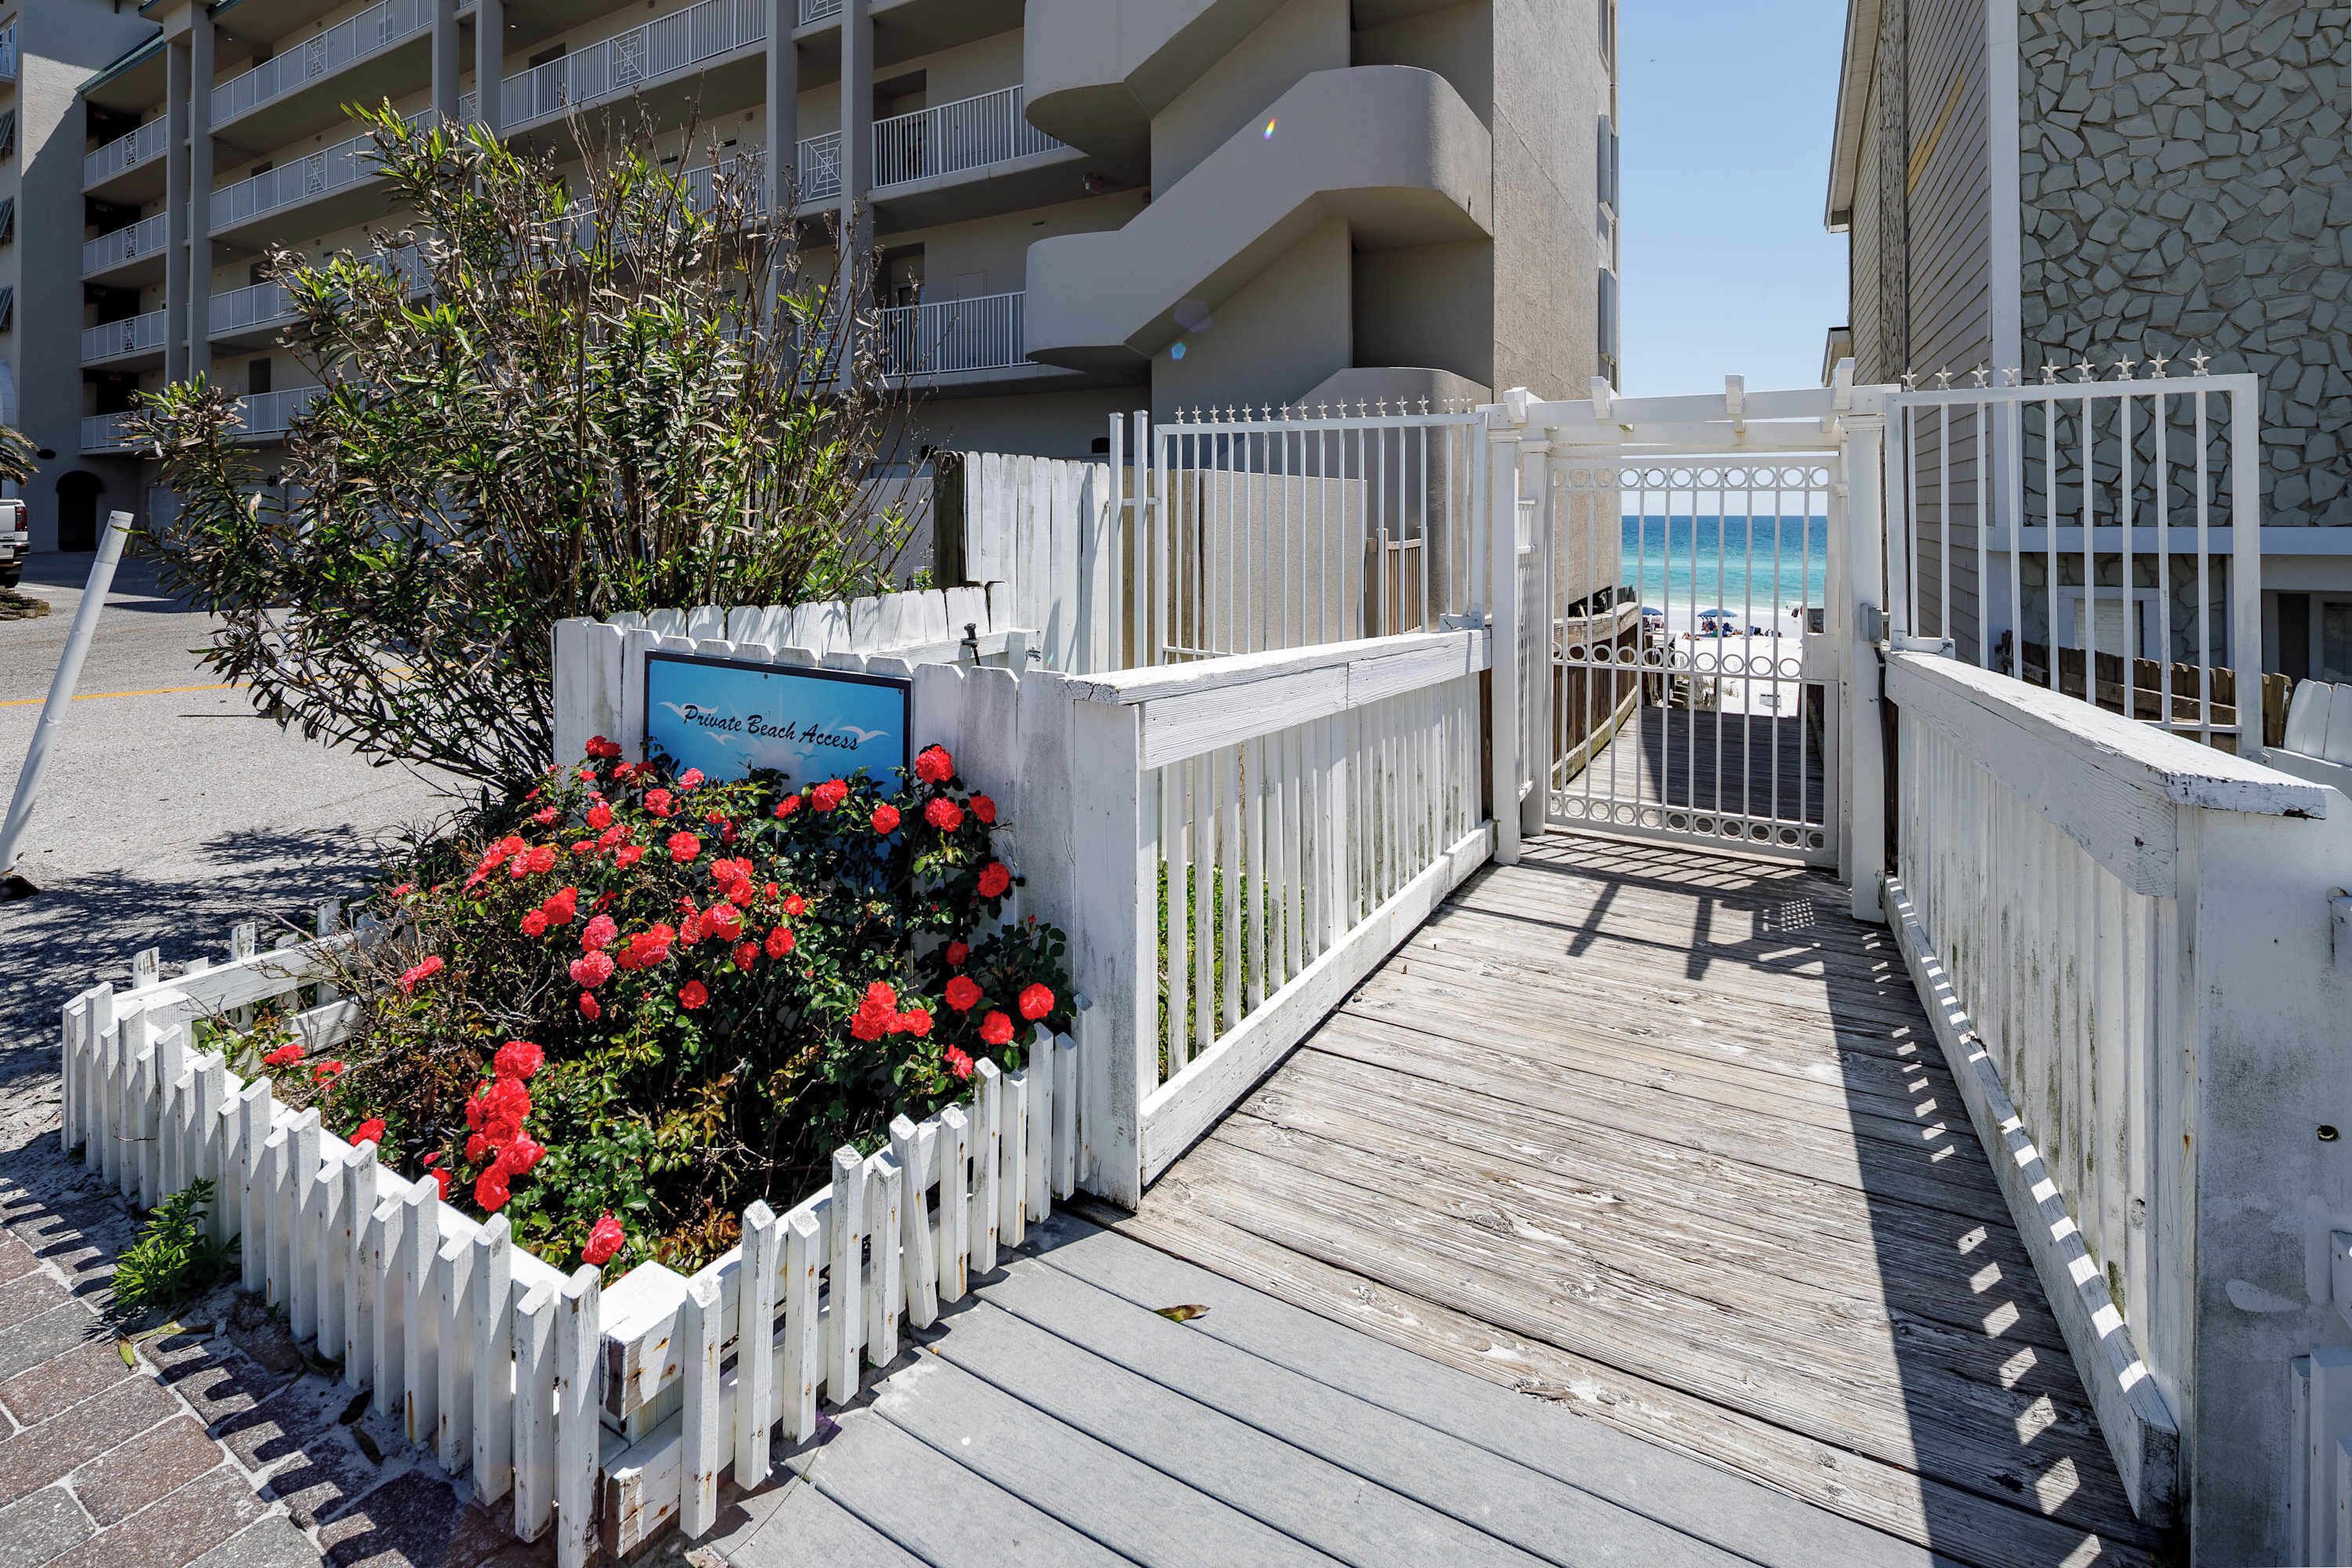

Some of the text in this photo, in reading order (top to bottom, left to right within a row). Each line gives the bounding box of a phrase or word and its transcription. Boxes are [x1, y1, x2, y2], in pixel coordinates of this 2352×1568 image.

[684, 705, 858, 750] Private Beach Access
